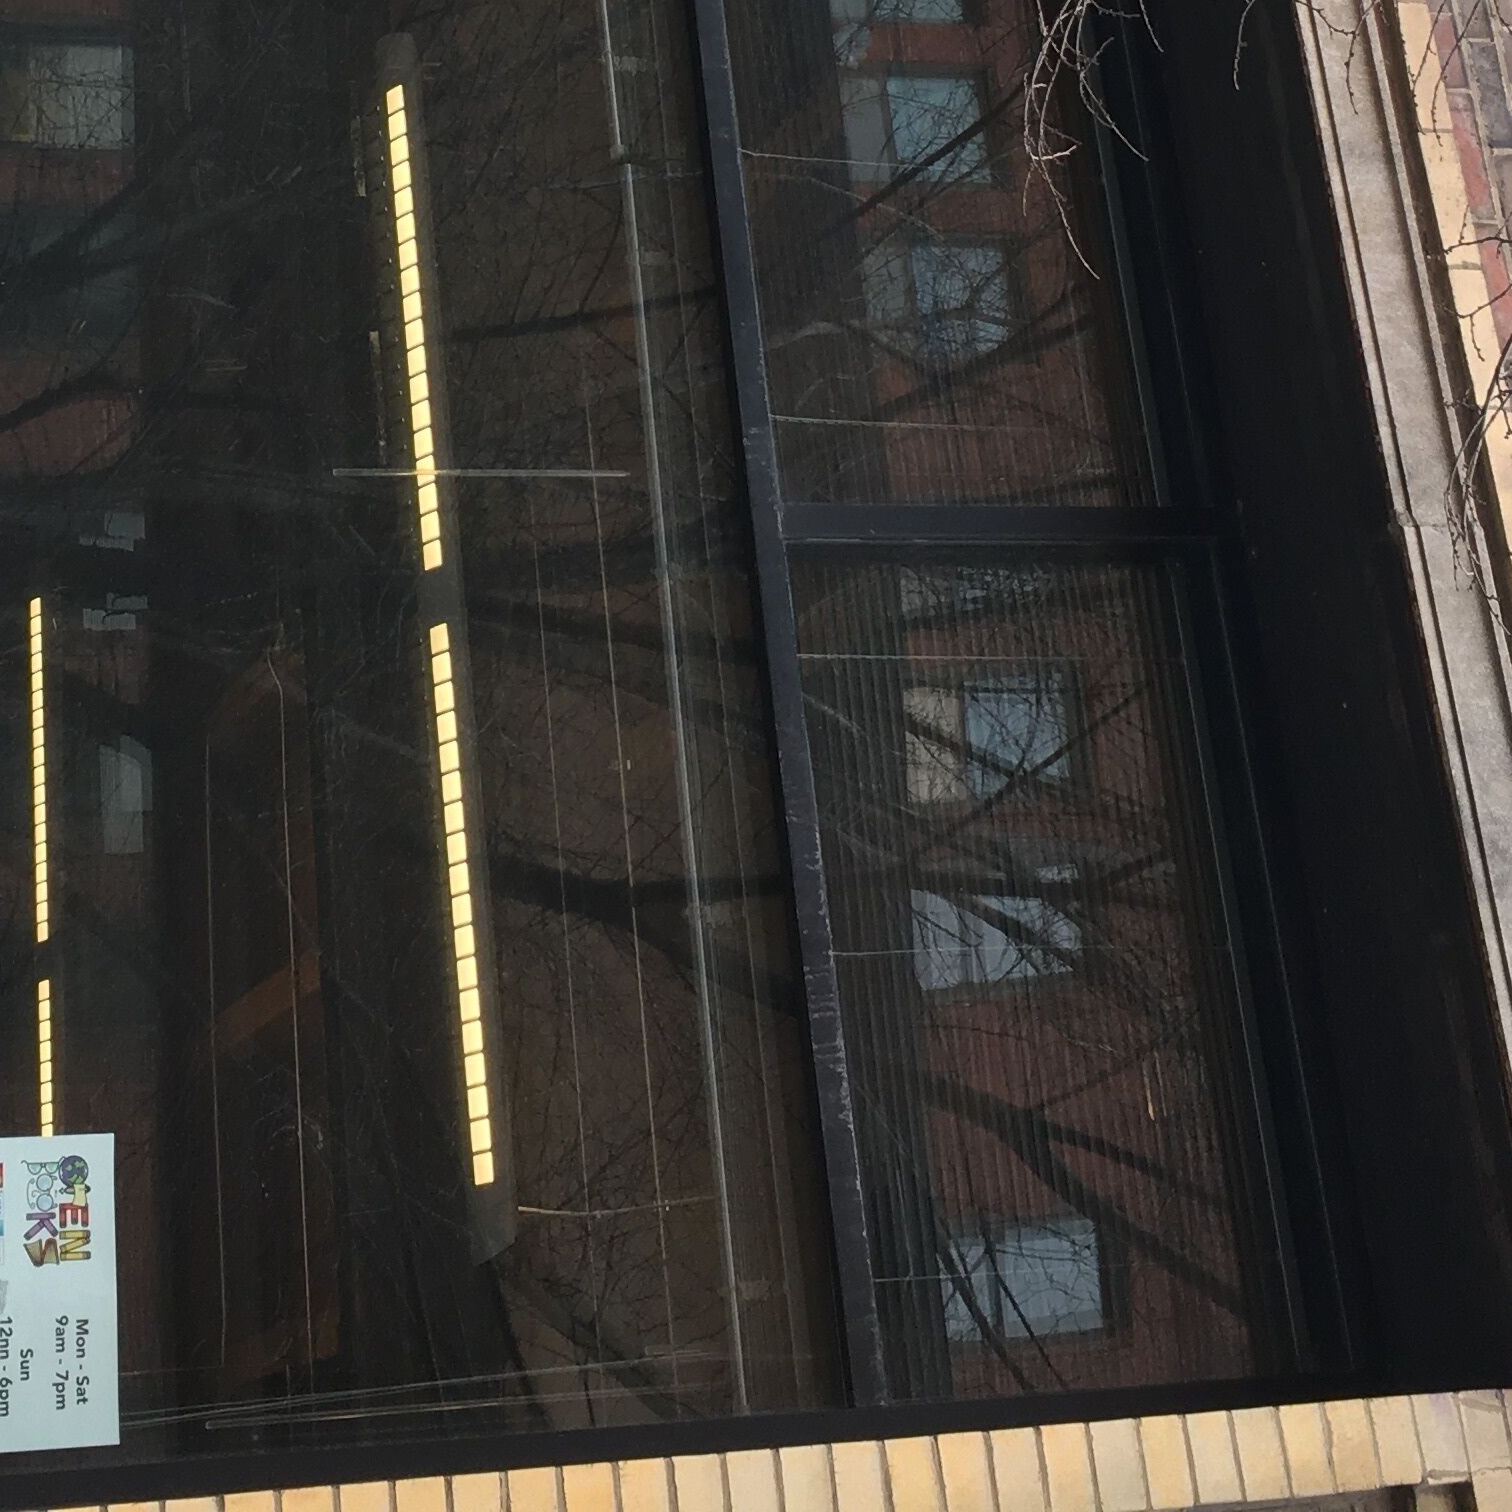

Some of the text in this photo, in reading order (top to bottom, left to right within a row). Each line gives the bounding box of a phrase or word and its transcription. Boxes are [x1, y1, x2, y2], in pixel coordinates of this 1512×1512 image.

[0, 1316, 13, 1359] 12nn
[56, 1315, 69, 1353] 9am
[76, 1319, 89, 1358] Mon
[20, 1349, 33, 1381] Sun
[52, 1370, 69, 1410] 7pm
[76, 1376, 89, 1404] Sat
